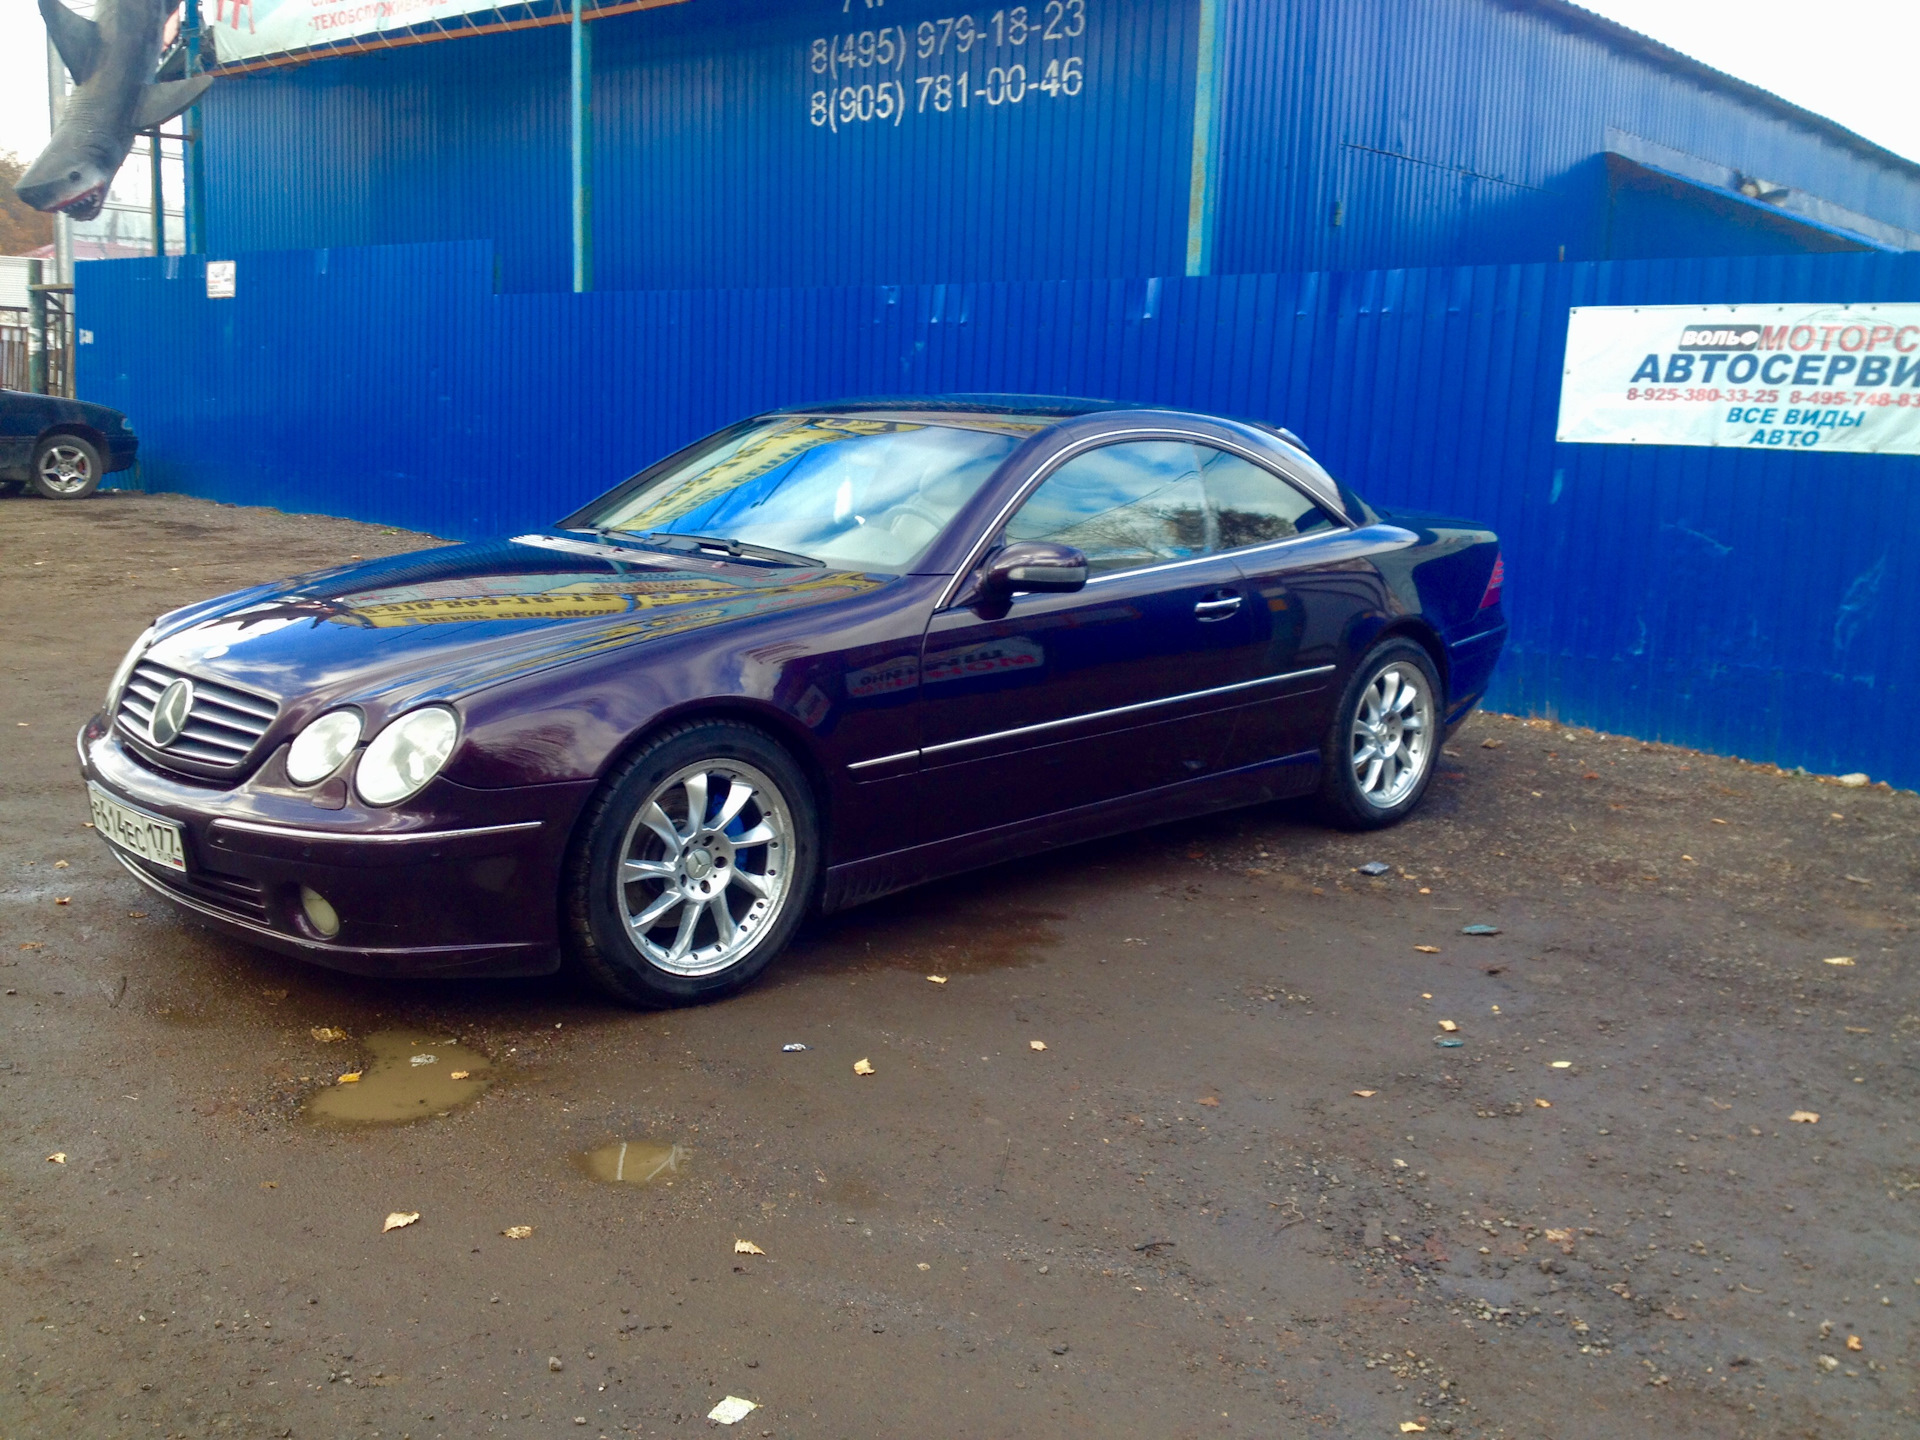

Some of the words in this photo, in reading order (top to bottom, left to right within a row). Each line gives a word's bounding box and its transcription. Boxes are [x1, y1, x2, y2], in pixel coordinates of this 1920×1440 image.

[811, 25, 906, 80] 8(495)
[917, 0, 1085, 58] 979-18-23
[811, 80, 905, 133] 8(905)
[916, 56, 1083, 113] 781-00-46
[1757, 324, 1920, 352] МОТОРС
[1630, 354, 1920, 387] АВТОСЕРВИ
[1626, 388, 1779, 403] 8-925-380-33-25
[1726, 407, 1778, 424] ВСЕ
[1783, 408, 1865, 429] ВИДЫ
[1749, 429, 1820, 447] АВТО
